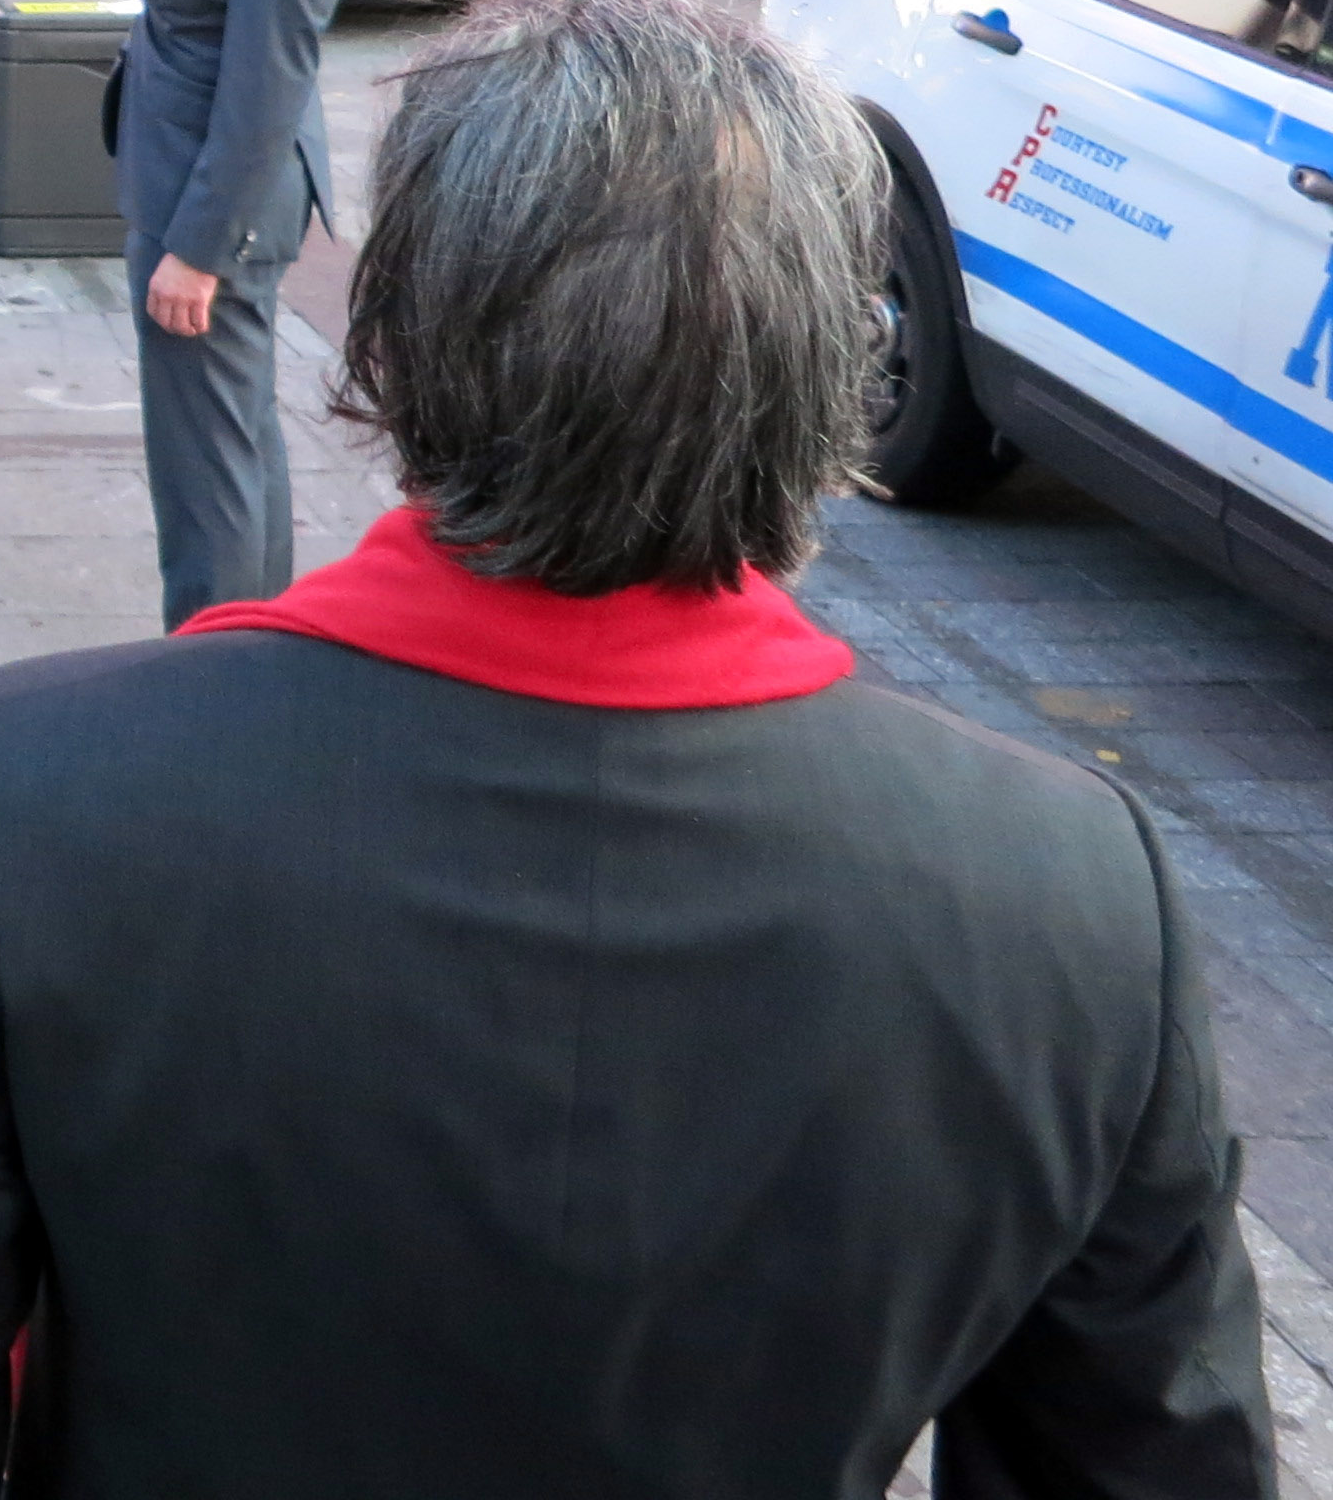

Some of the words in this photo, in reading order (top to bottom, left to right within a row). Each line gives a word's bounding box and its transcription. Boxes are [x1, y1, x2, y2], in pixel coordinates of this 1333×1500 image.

[1035, 102, 1129, 173] COURTESY
[985, 166, 1076, 235] RESPECT
[1010, 134, 1174, 242] PROFESSIONALISM
